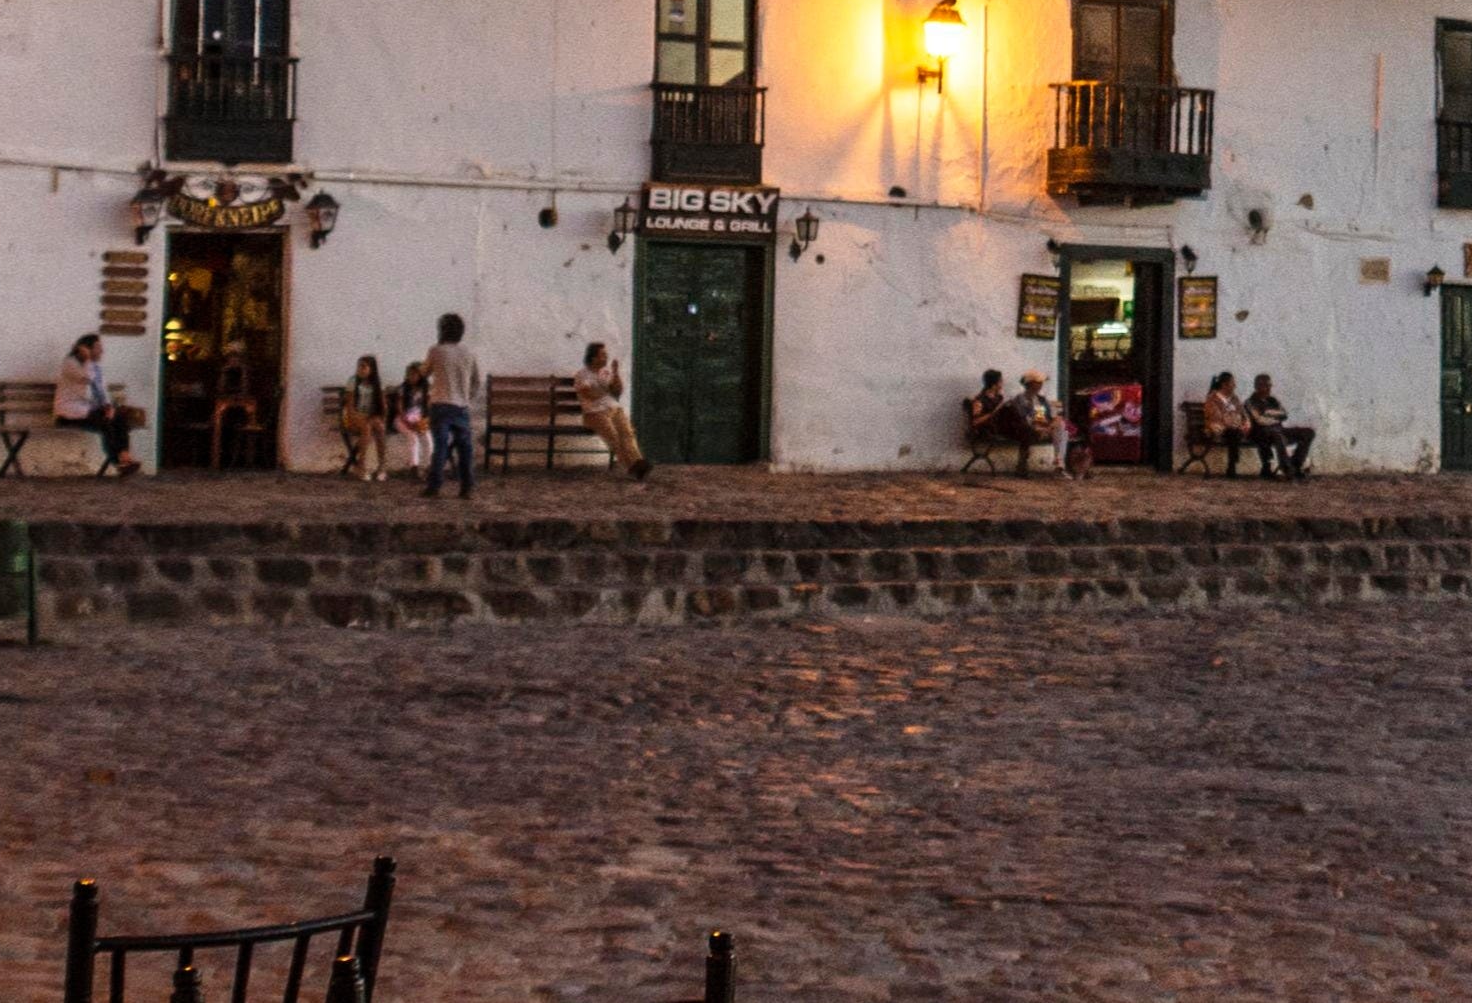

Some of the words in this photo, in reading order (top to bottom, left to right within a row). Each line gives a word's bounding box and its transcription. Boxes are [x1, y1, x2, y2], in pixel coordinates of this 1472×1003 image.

[648, 187, 705, 212] BIG
[708, 190, 776, 215] SKY
[646, 217, 710, 231] LOUNGE
[712, 219, 726, 232] &
[729, 220, 771, 233] GRILL
